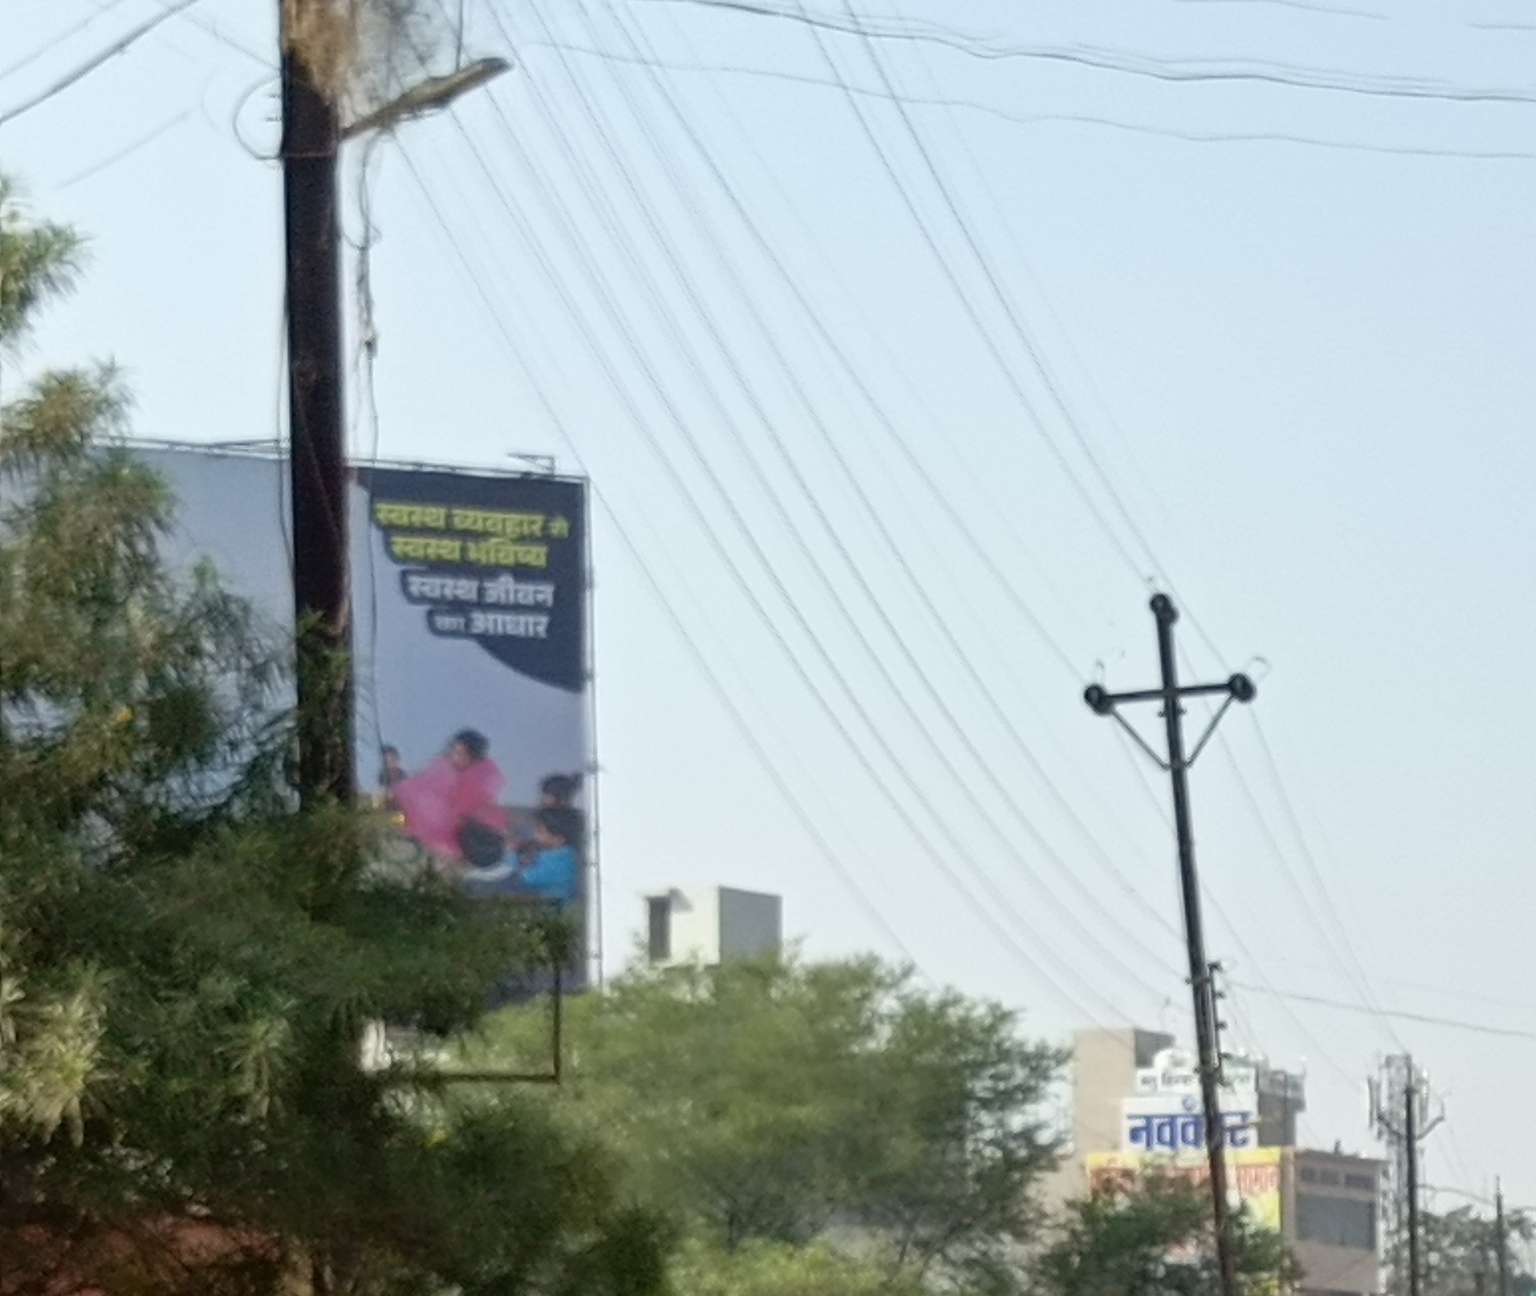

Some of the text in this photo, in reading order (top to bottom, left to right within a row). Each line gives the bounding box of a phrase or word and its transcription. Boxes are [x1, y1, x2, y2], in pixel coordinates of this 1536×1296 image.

[376, 504, 447, 529] स्वस्थ
[390, 536, 461, 562] स्वस्थ
[406, 575, 480, 602] स्वस्थ
